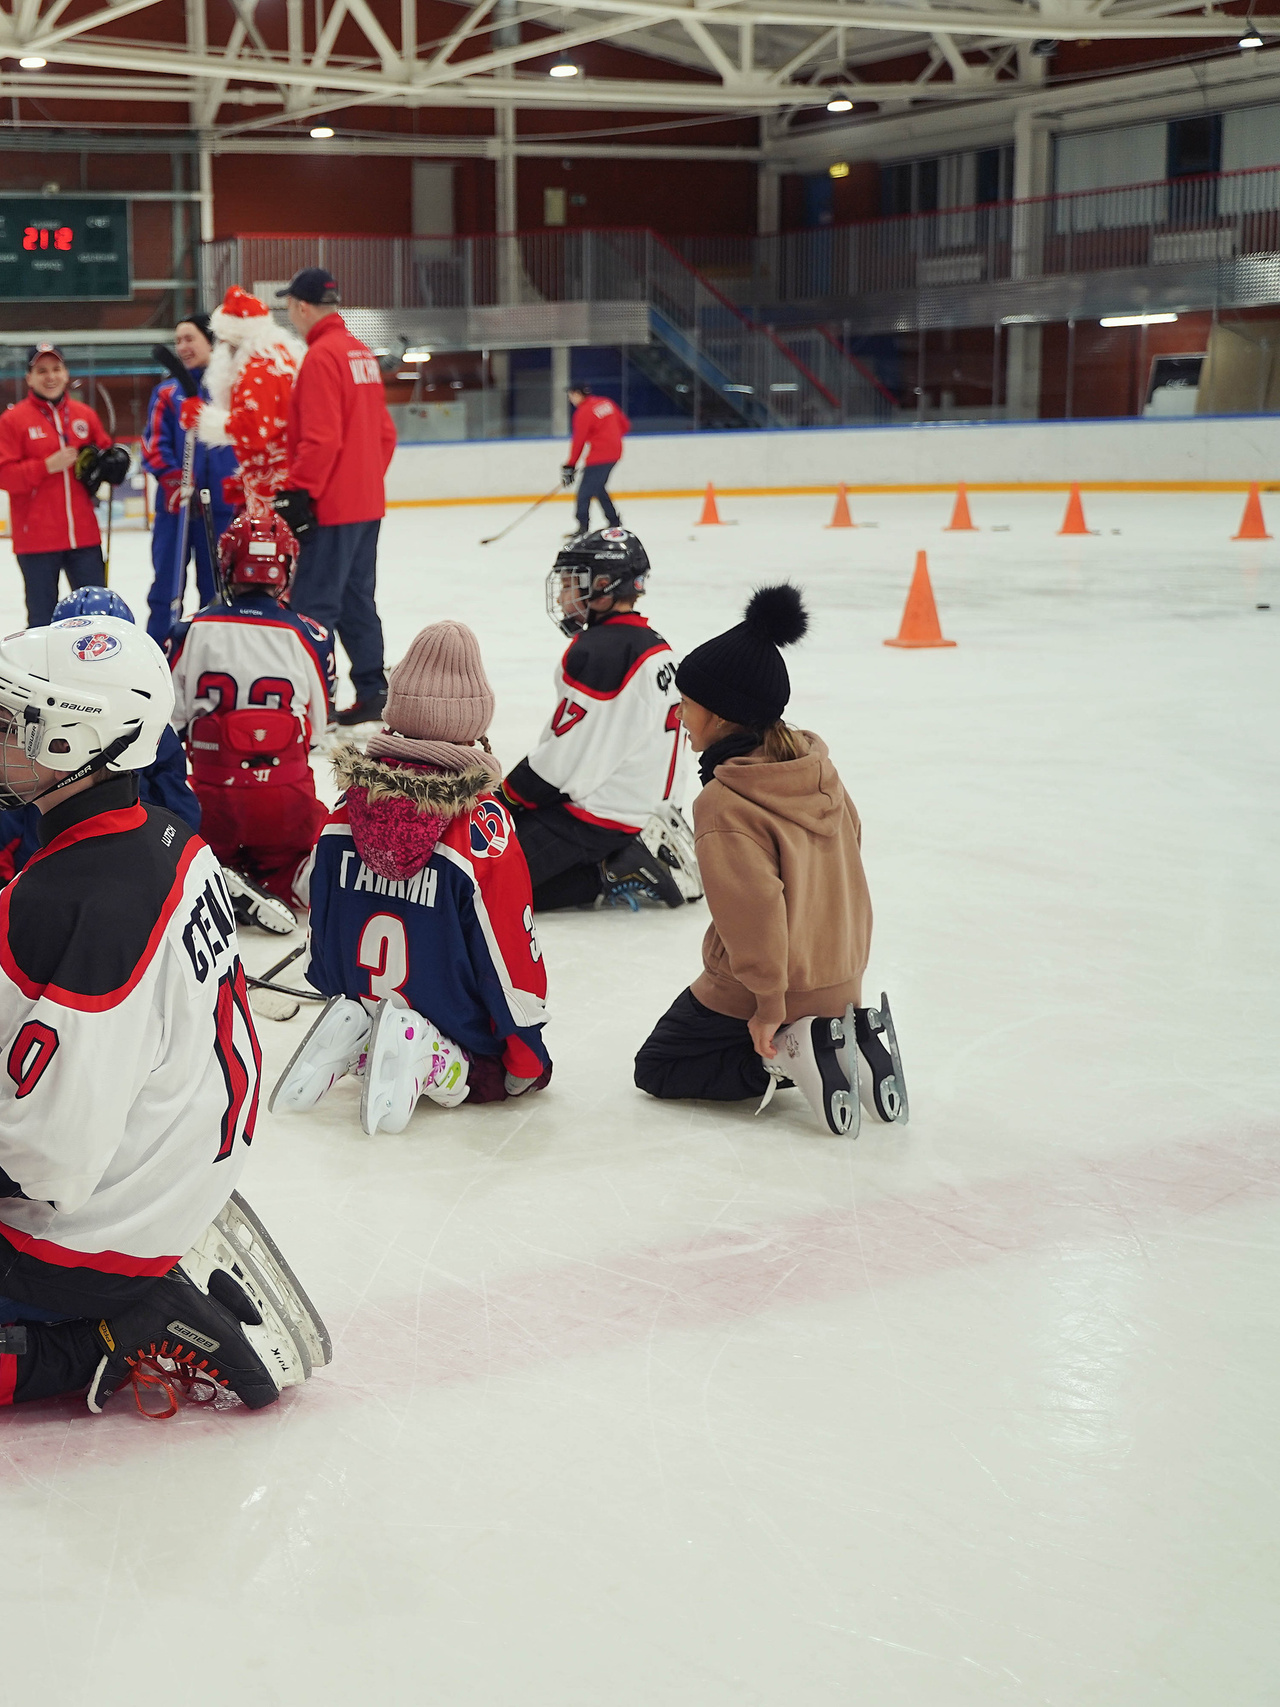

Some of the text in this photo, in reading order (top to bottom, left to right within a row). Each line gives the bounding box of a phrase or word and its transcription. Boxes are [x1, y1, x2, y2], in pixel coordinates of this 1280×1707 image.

[59, 702, 103, 715] BAUER
[56, 764, 94, 789] BAUER
[160, 824, 177, 848] LUTCH
[355, 911, 416, 1012] 3
[174, 1324, 214, 1348] BAUER
